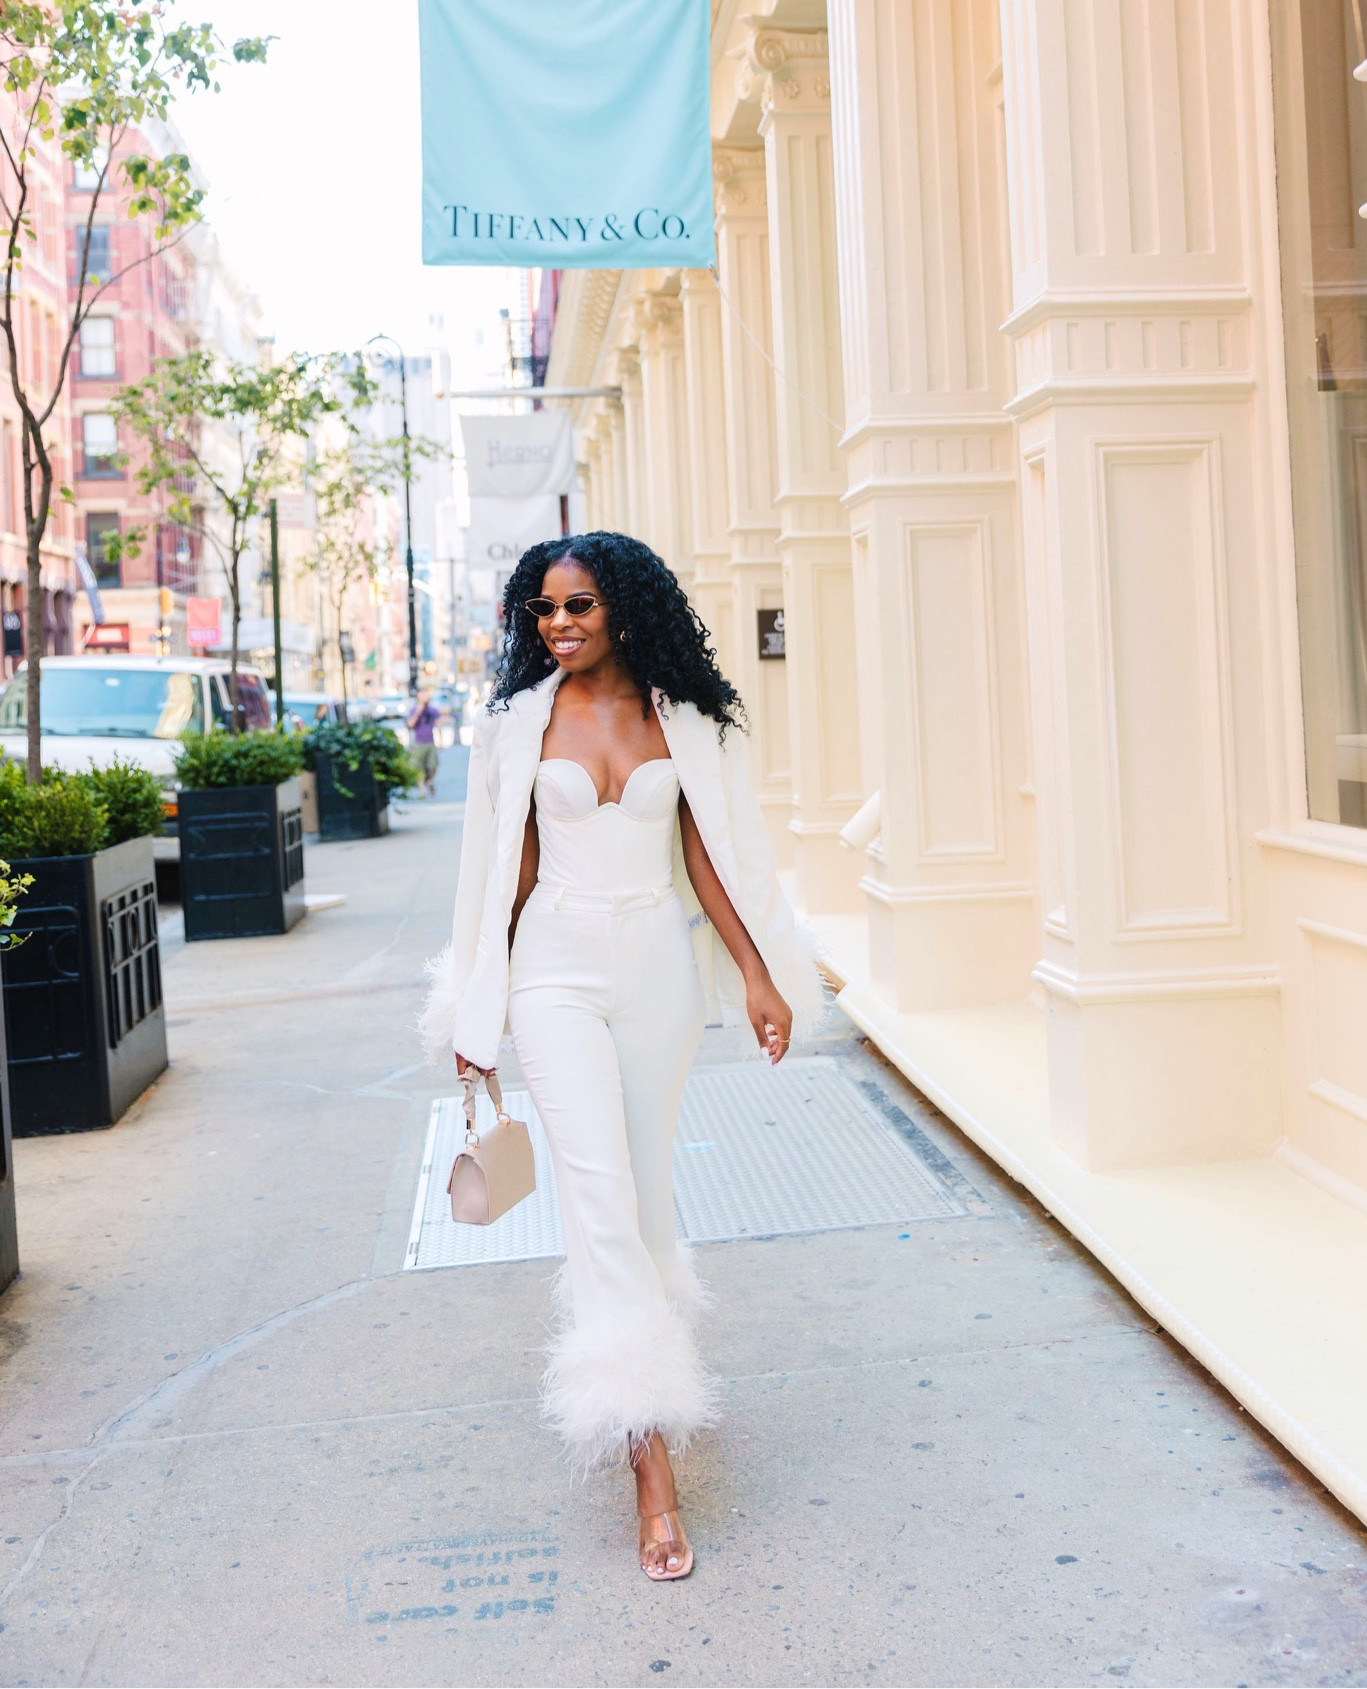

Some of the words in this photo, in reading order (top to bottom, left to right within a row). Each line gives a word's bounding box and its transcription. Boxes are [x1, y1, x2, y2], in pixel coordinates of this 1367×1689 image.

[443, 205, 593, 242] TIFFANY
[600, 213, 626, 240] &
[487, 542, 525, 561] Chl
[443, 1574, 510, 1593] not
[527, 1571, 559, 1593] is
